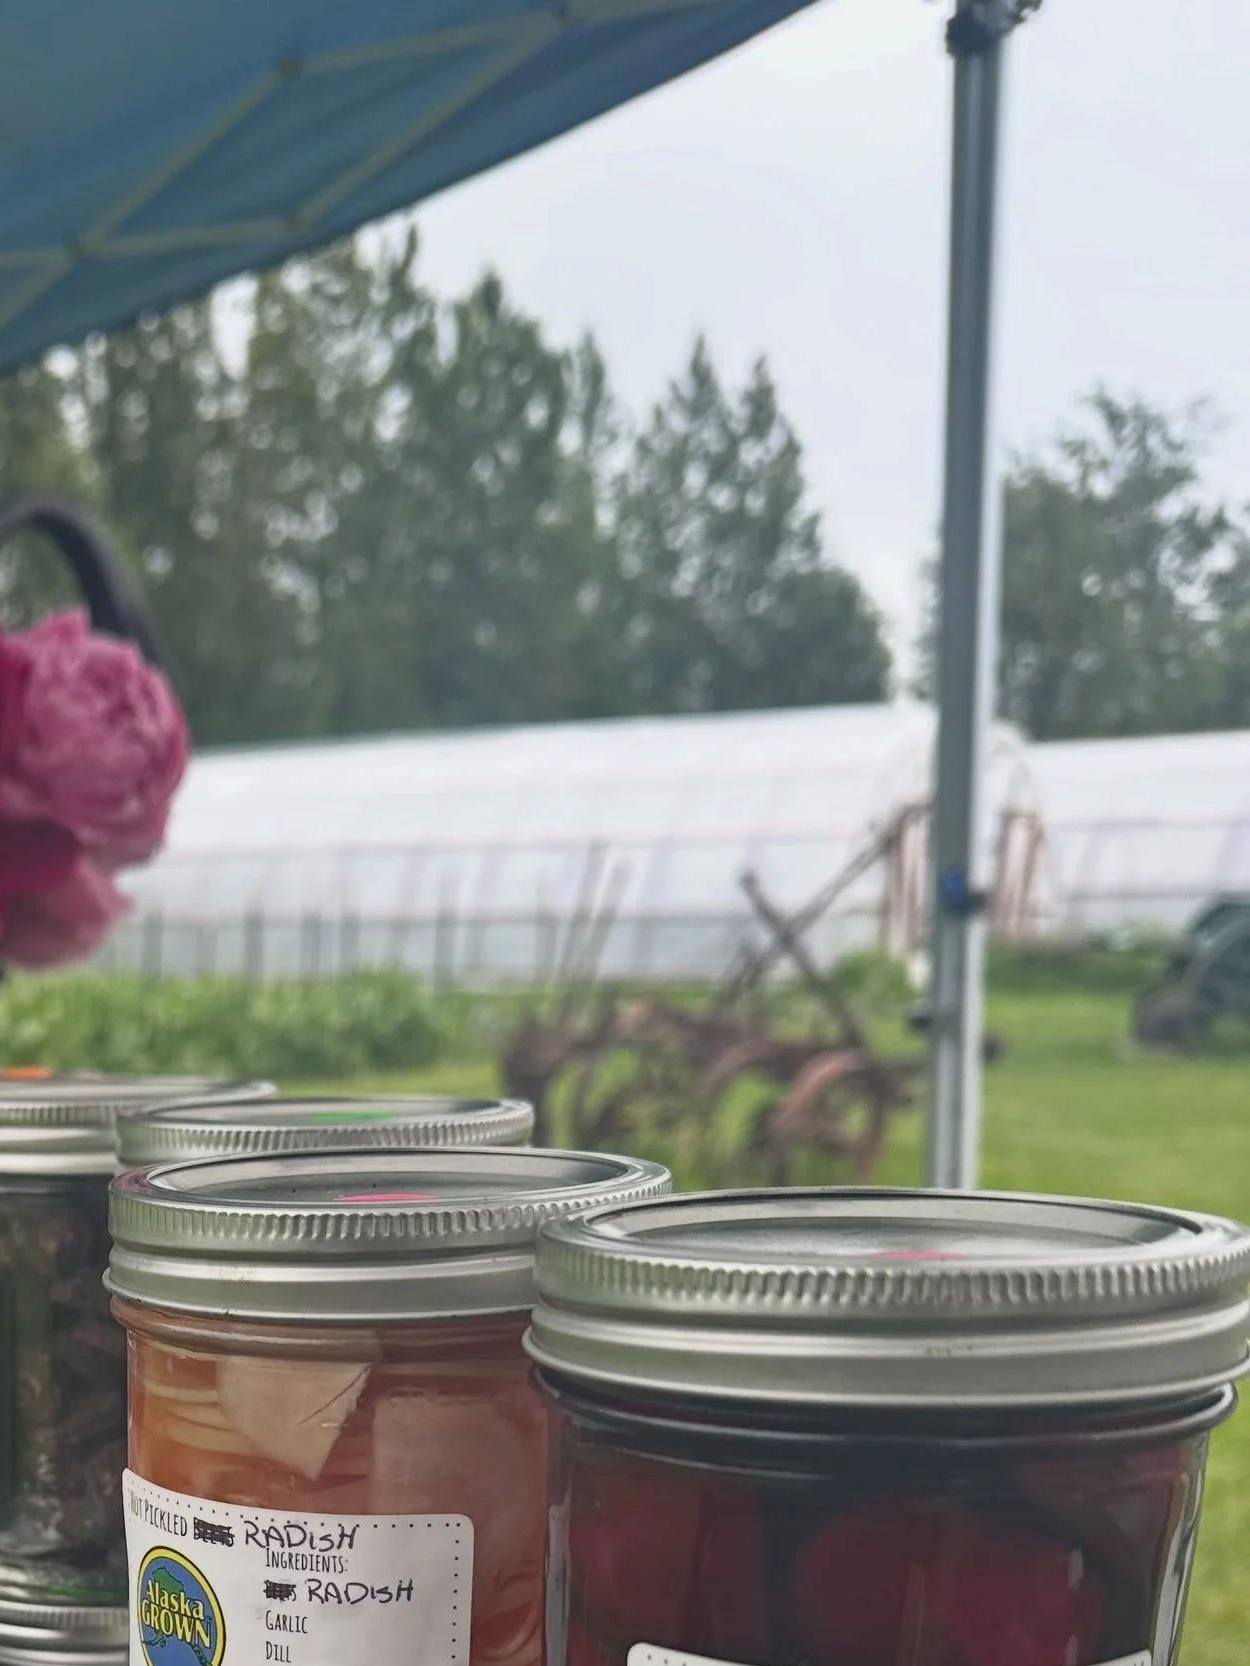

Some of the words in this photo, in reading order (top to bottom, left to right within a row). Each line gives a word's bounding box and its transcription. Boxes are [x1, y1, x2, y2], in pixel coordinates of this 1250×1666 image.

[144, 1499, 188, 1537] PICKLED
[265, 1548, 349, 1575] INGREDIENTS:
[145, 1579, 205, 1621] Alaska
[305, 1578, 414, 1605] RADISH
[141, 1598, 212, 1648] GROWN
[265, 1610, 308, 1635] GARLIC
[265, 1641, 291, 1664] DILL
